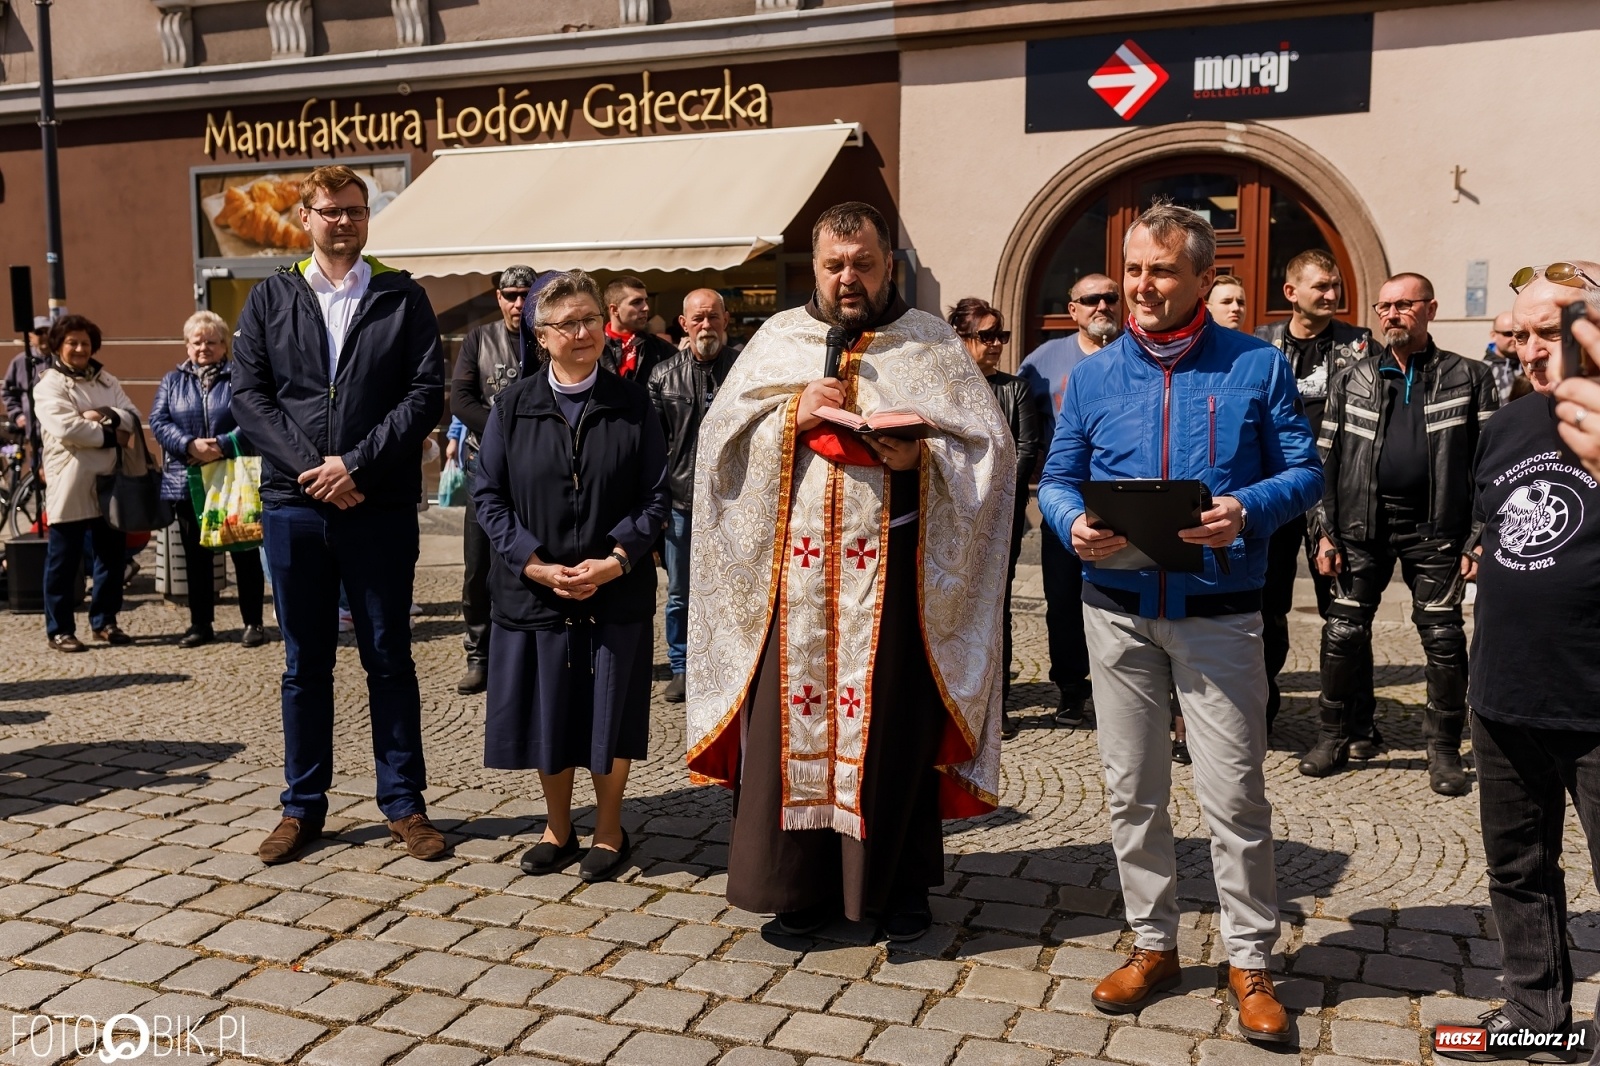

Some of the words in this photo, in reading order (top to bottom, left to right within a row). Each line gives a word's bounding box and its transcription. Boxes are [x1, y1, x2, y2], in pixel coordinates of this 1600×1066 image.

[1193, 86, 1270, 99] COLLECTION
[204, 97, 422, 155] Manufaktura
[435, 87, 569, 142] Lodów
[582, 68, 768, 132] Gałeczka
[1493, 474, 1505, 487] 25
[1508, 462, 1598, 489] MOTOCYKLOWEGO
[1493, 548, 1526, 571] Racibórz
[1529, 556, 1556, 571] 2022
